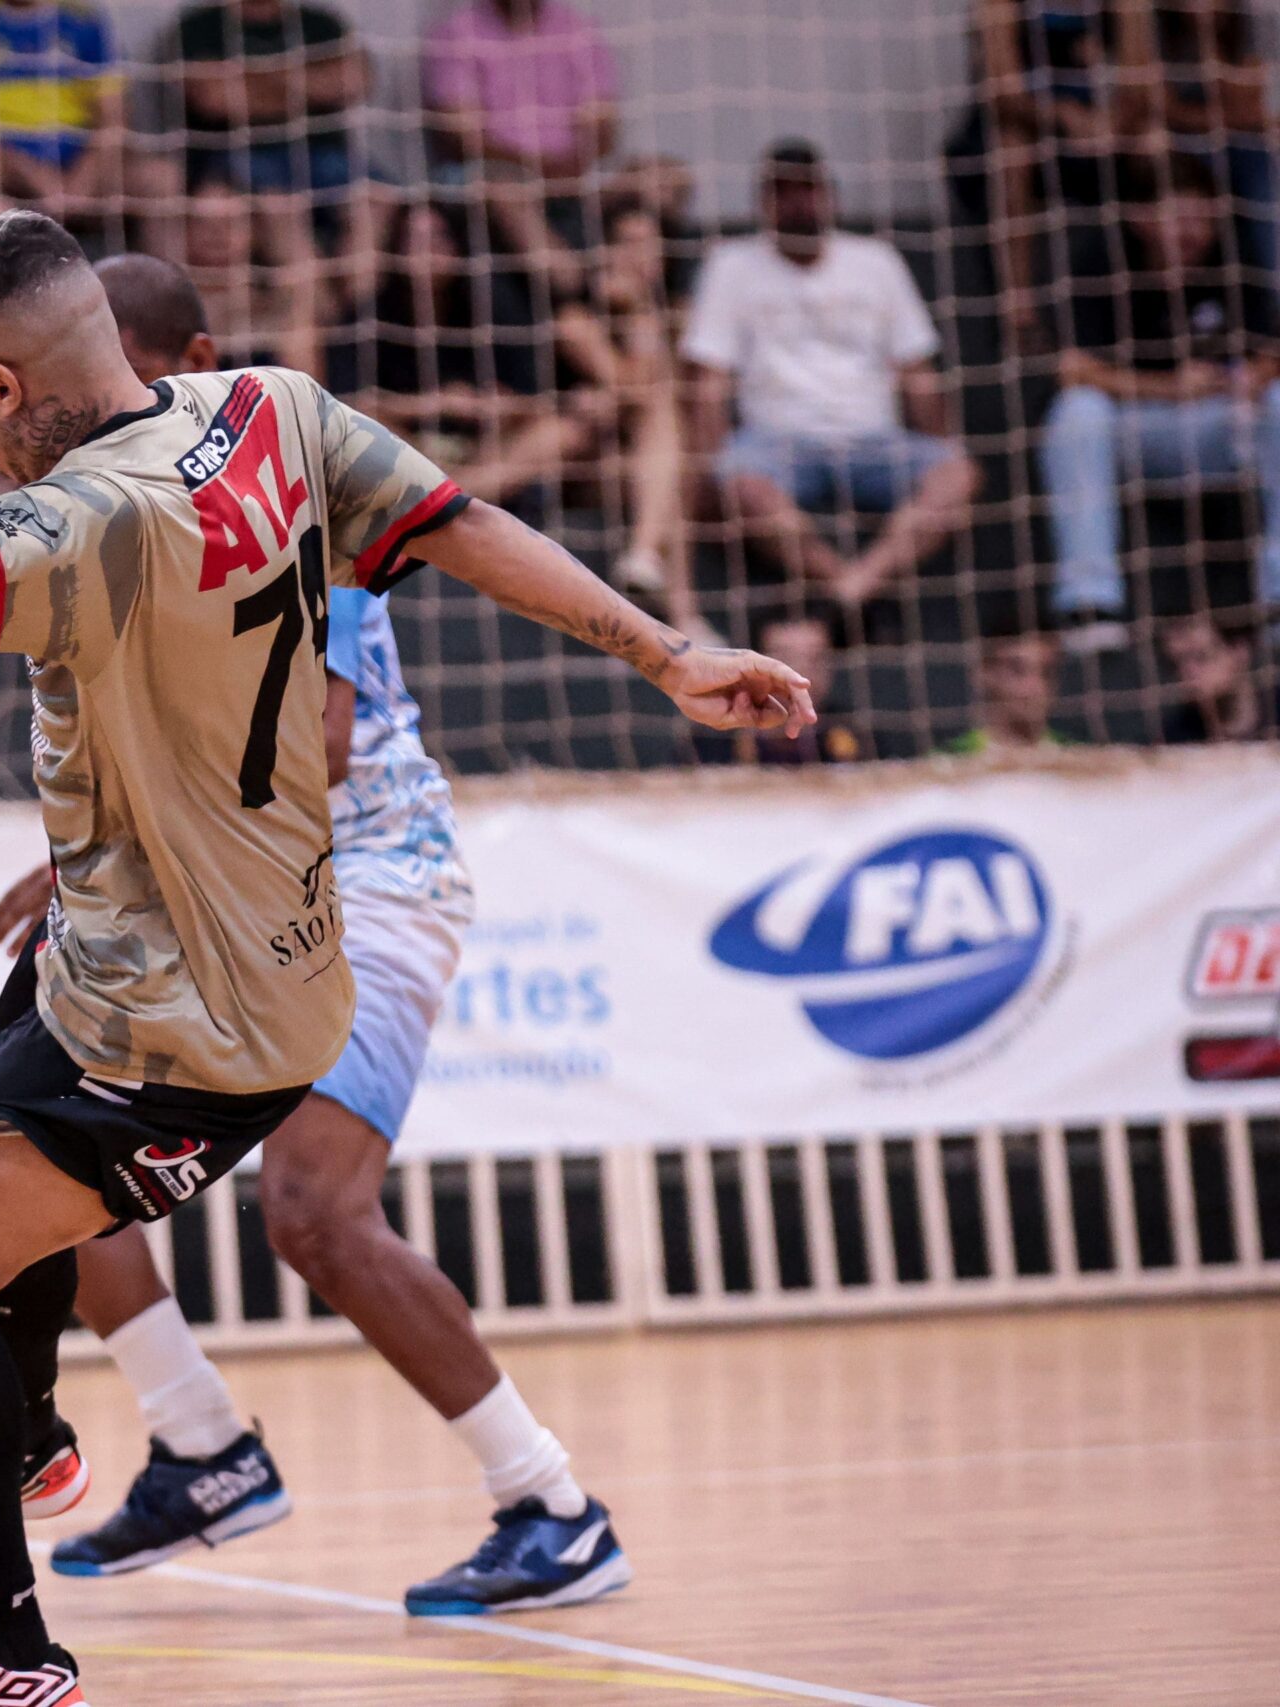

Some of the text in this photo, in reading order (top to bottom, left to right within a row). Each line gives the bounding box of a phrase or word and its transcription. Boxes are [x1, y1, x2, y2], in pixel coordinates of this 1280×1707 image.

[270, 916, 325, 966] SÃO
[844, 853, 1038, 964] FAI
[457, 961, 612, 1026] rtes
